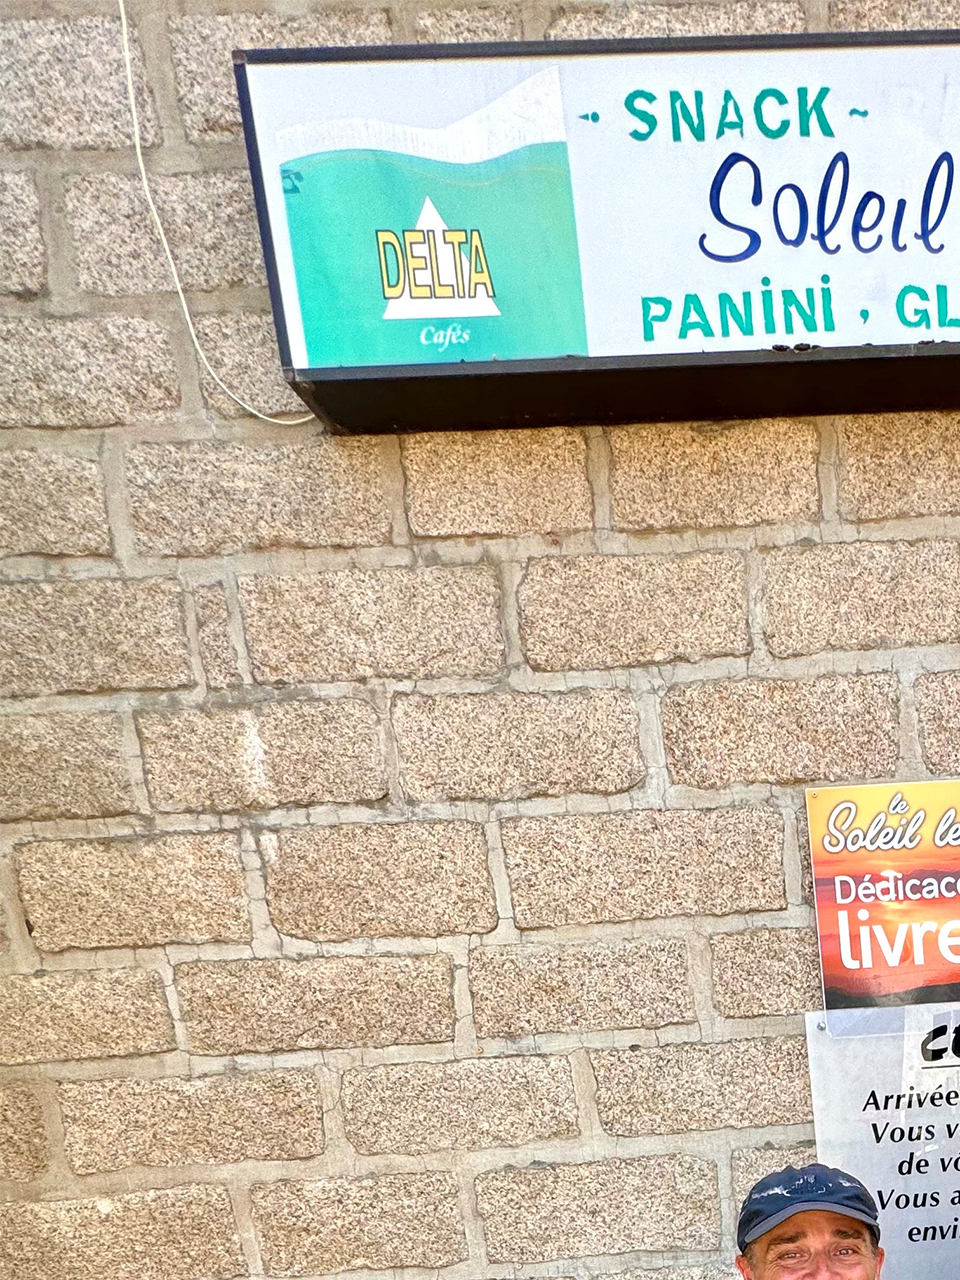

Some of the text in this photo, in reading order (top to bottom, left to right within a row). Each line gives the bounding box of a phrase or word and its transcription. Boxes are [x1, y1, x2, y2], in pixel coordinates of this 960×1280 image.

[624, 86, 835, 142] SNACK
[699, 151, 955, 263] Soleil
[375, 229, 496, 300] DELTA
[420, 323, 471, 352] Cafés
[889, 792, 910, 814] le
[823, 801, 926, 853] Soleil
[862, 1084, 959, 1112] Arrivée
[871, 1120, 936, 1144] Vous
[898, 1152, 930, 1176] de
[876, 1187, 941, 1211] Vous
